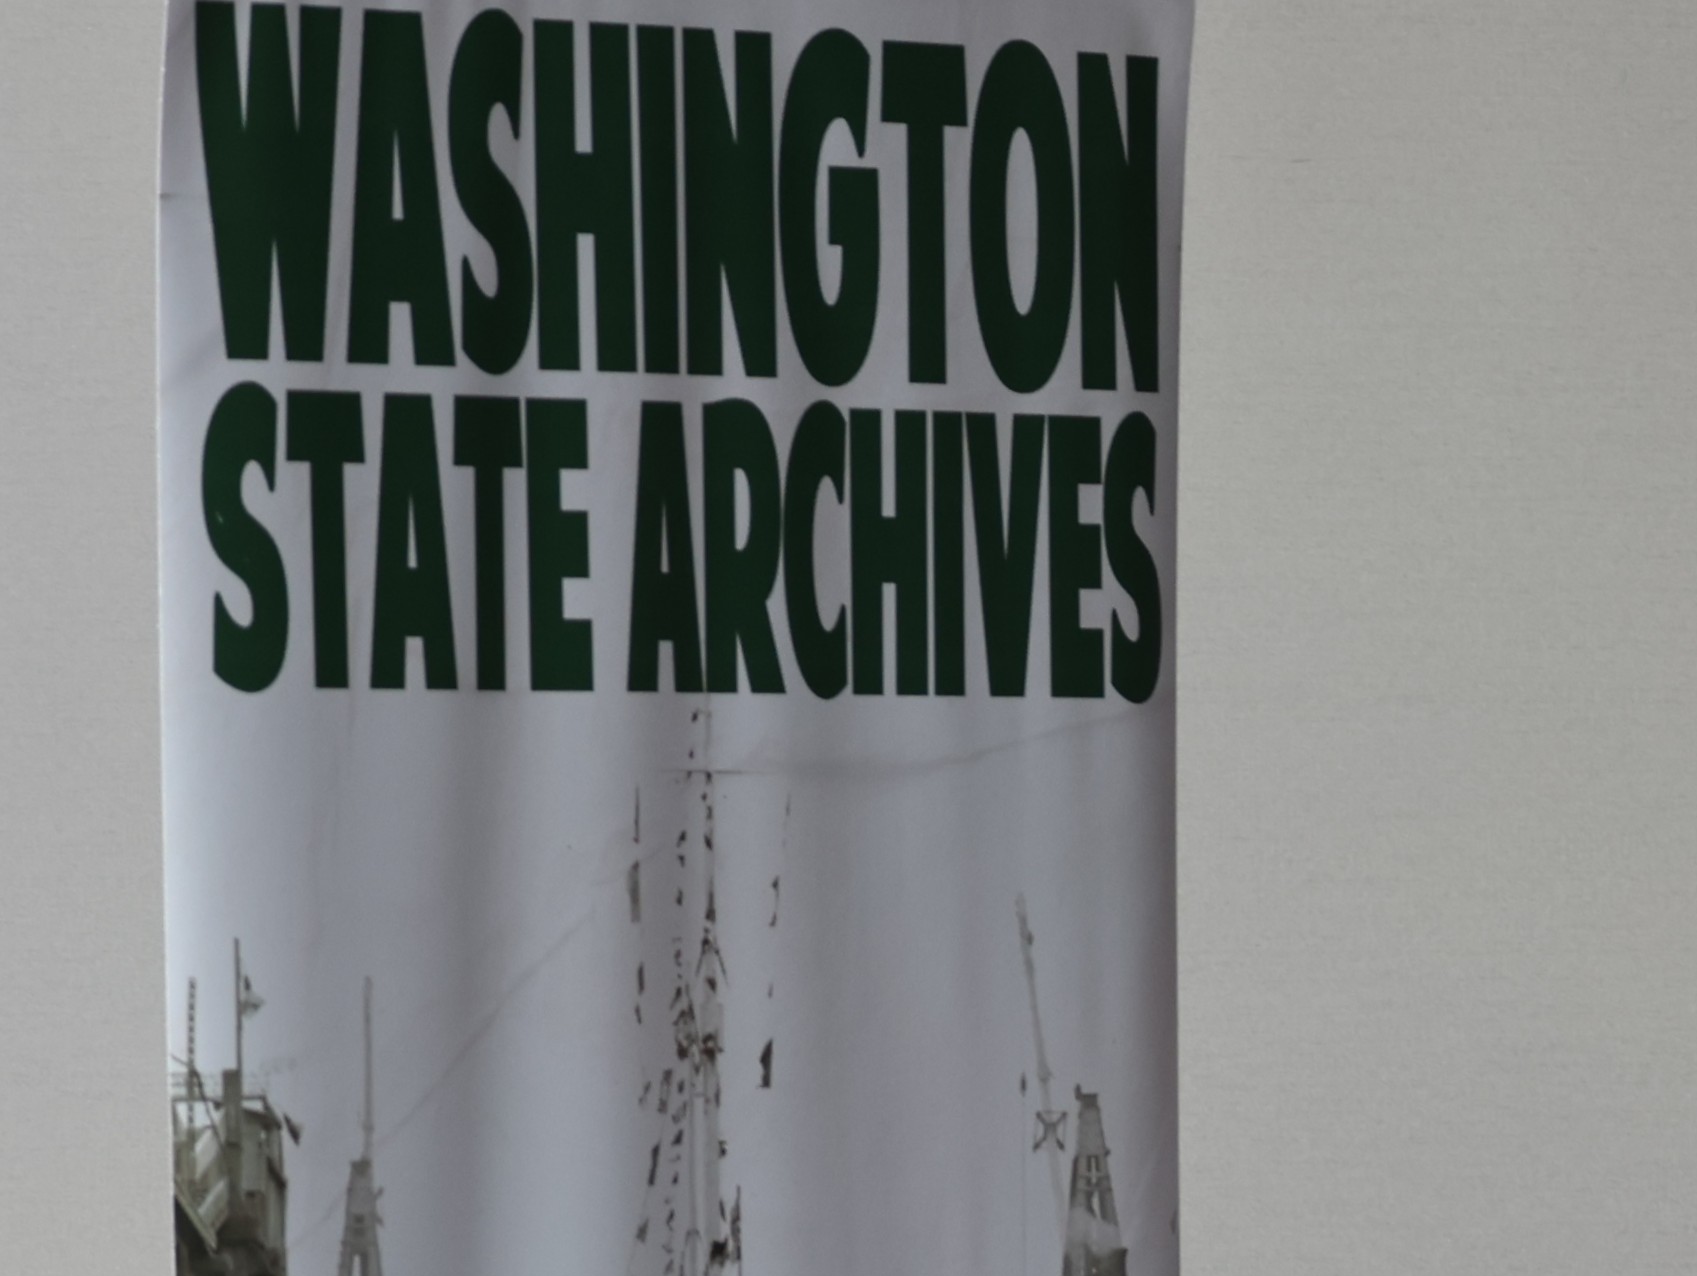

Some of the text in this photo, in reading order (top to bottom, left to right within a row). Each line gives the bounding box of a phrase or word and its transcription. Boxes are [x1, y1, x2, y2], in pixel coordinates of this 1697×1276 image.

[195, 0, 1159, 394] WASHINGTON
[201, 380, 1163, 704] STATE ARCHIVES
